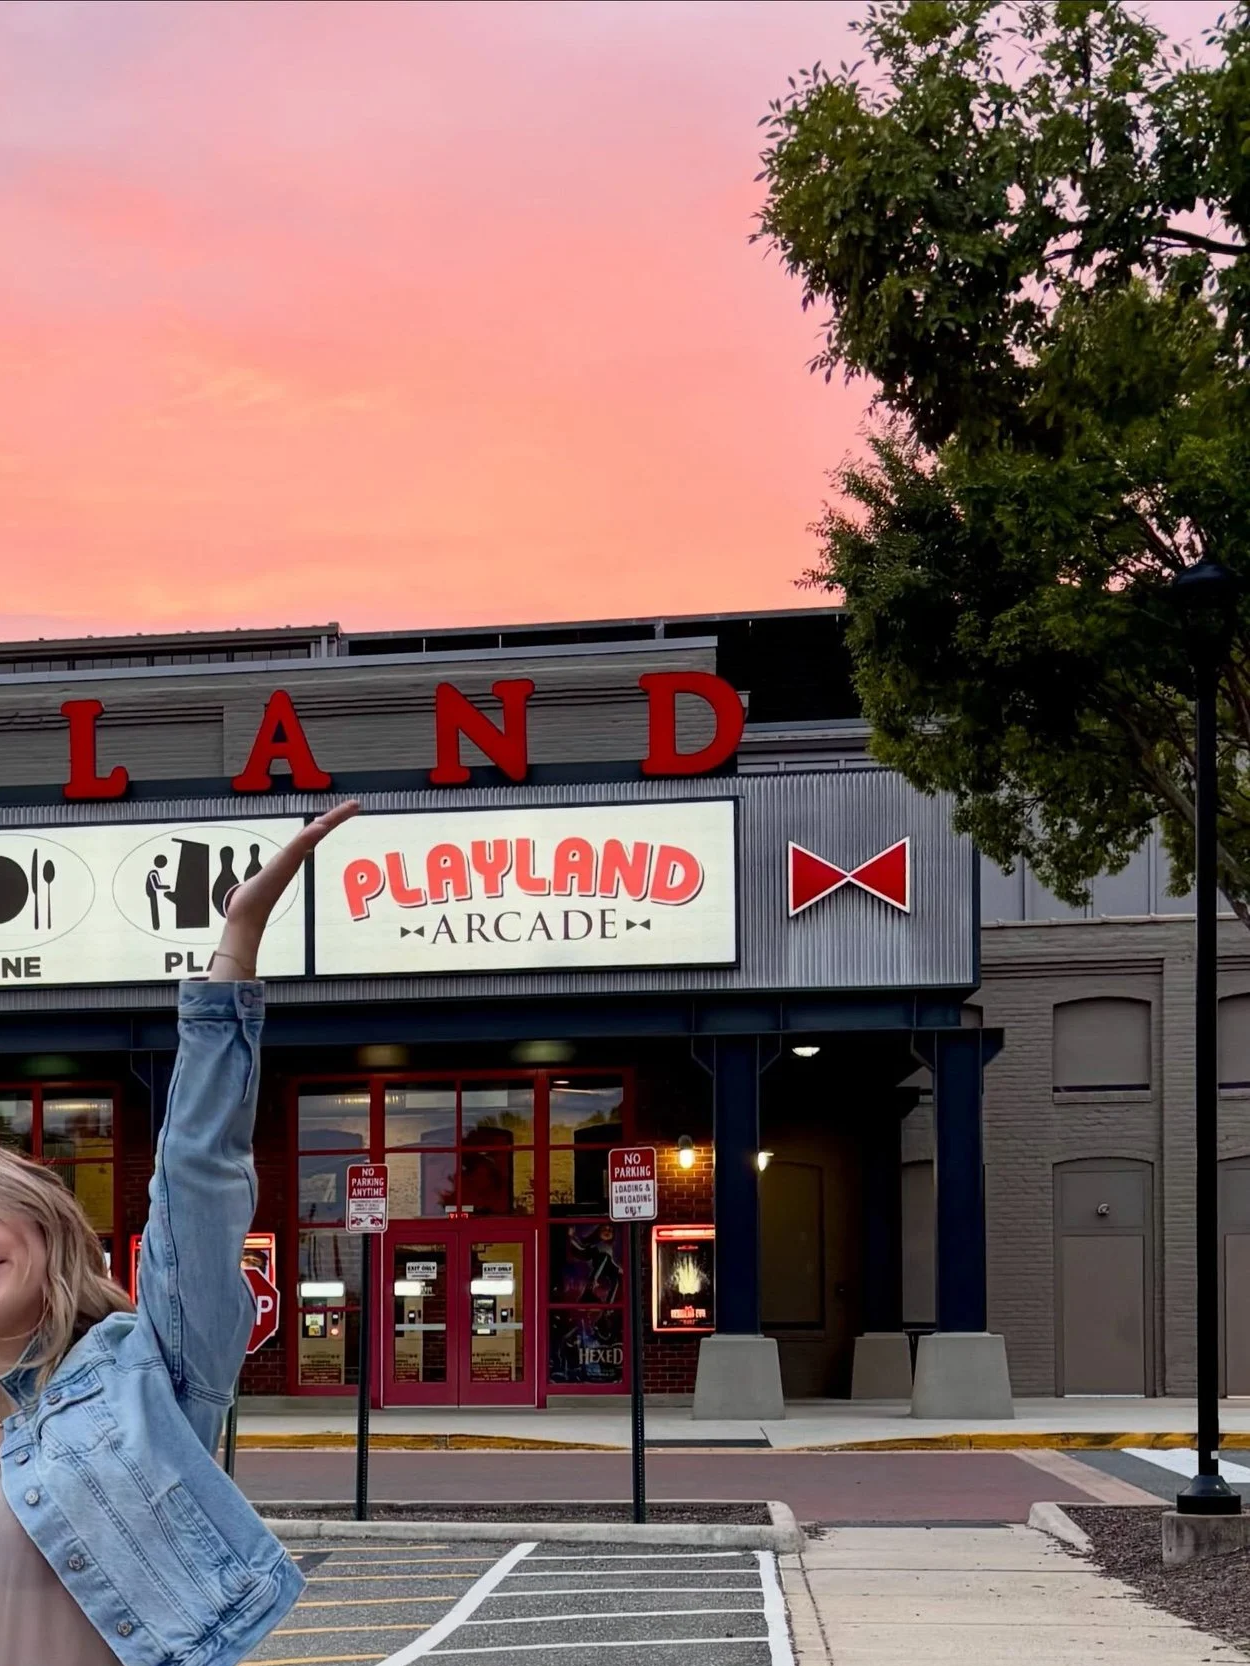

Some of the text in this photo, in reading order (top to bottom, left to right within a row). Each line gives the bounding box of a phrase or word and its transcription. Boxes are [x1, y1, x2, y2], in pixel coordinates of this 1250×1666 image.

[342, 837, 704, 921] PLAYLAND
[432, 908, 618, 944] ARCADE
[165, 951, 217, 973] PL
[624, 1153, 641, 1165] NO
[361, 1167, 375, 1176] NO
[614, 1165, 651, 1178] PARKING
[351, 1177, 385, 1187] PARKING
[351, 1187, 385, 1197] ANYTIME
[615, 1183, 651, 1193] LOADING &
[614, 1195, 652, 1204] UNLOADING
[624, 1205, 642, 1215] ONLY
[579, 1348, 624, 1365] HEXED
